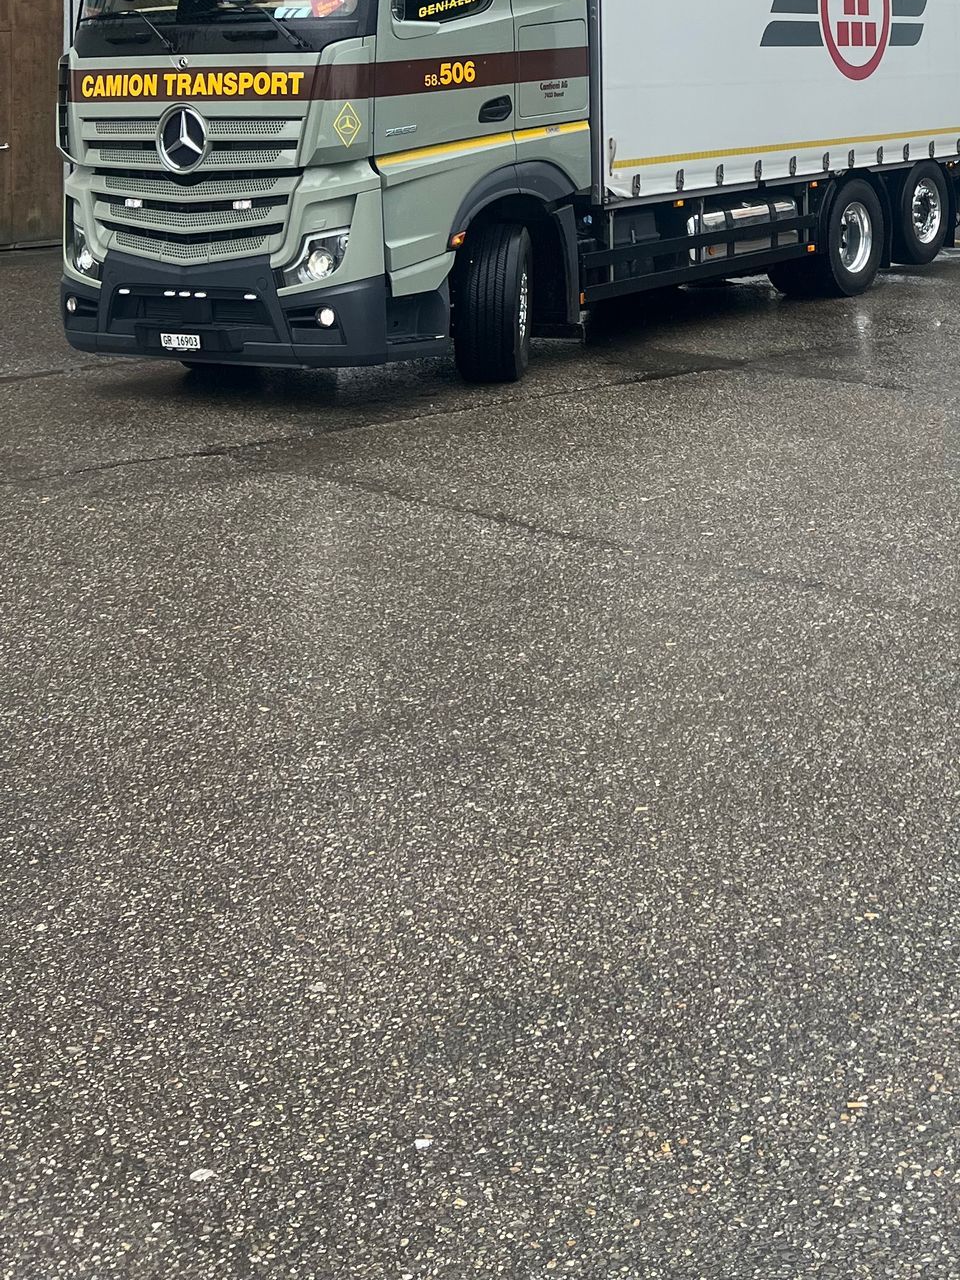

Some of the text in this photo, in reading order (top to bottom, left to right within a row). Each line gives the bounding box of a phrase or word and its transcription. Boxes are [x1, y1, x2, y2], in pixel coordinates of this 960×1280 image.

[81, 71, 305, 98] CAMION TRANSPORT
[424, 60, 476, 87] 58.506
[163, 335, 199, 347] GR 16903
